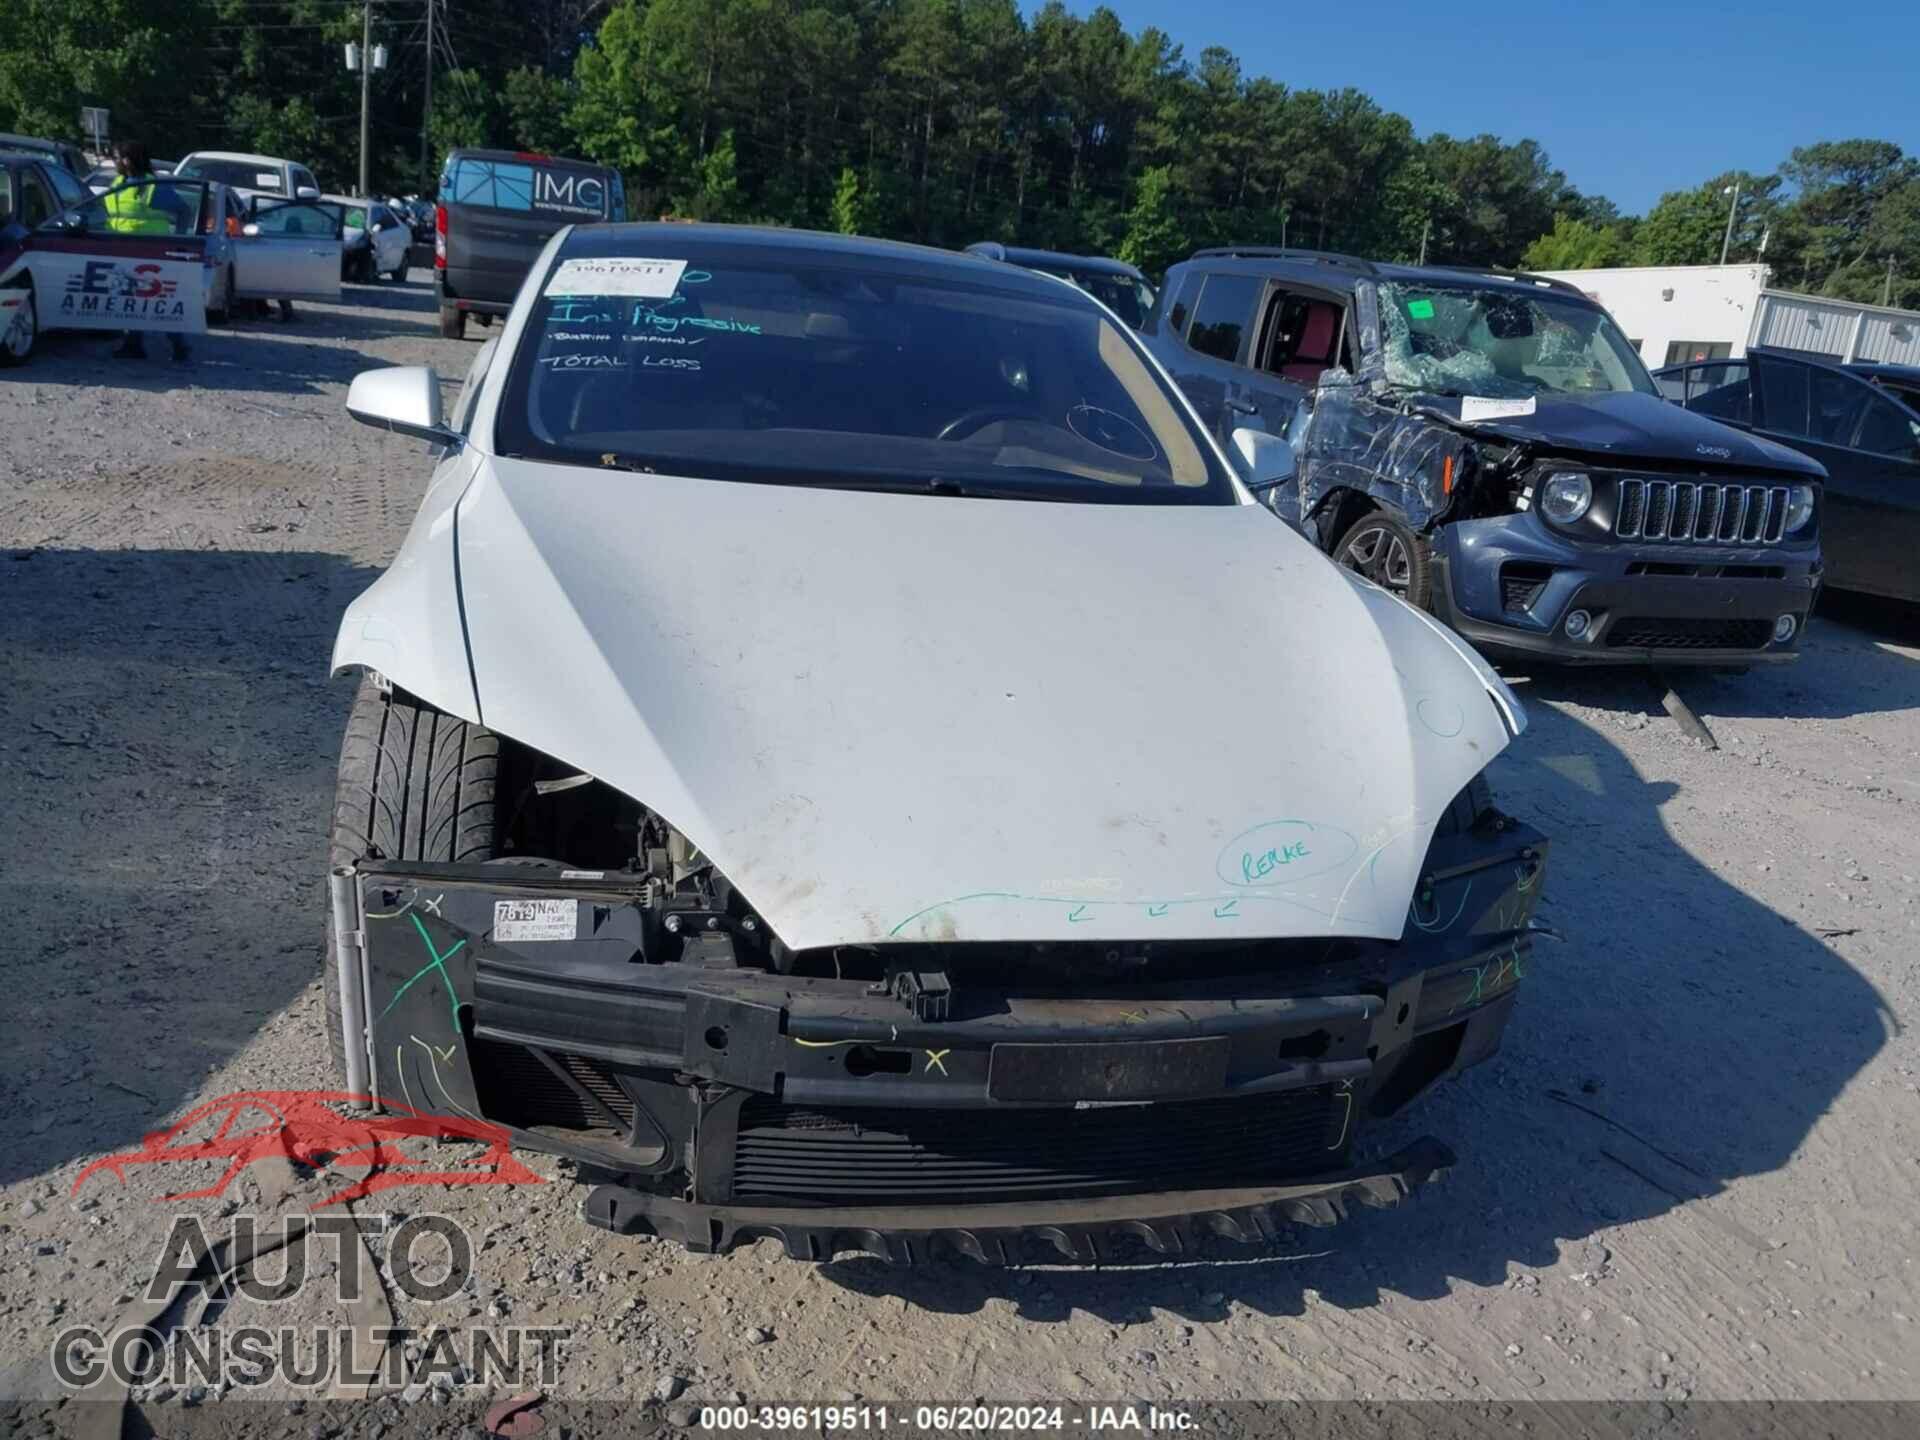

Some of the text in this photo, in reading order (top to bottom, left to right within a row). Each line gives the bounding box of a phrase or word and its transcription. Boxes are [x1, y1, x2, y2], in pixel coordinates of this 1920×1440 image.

[535, 171, 602, 206] IMG
[61, 294, 184, 315] AMERICA
[540, 354, 702, 370] TOTAL LOSS
